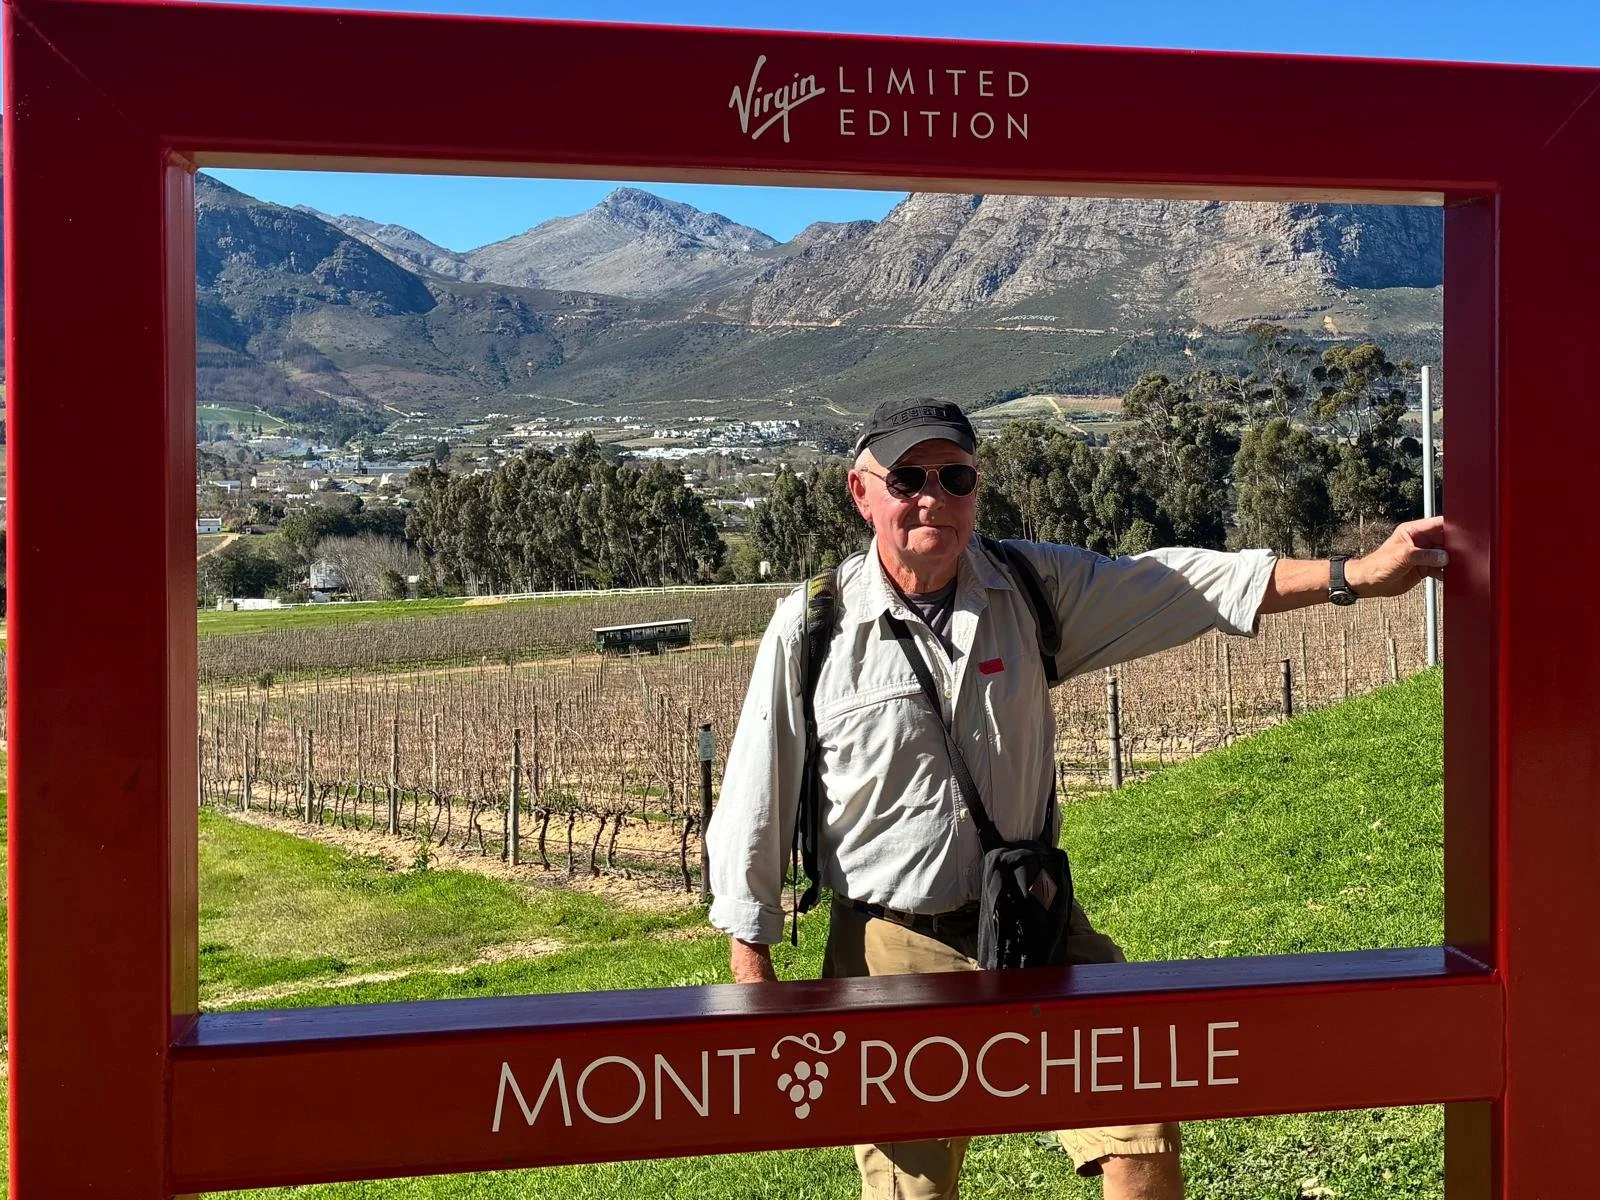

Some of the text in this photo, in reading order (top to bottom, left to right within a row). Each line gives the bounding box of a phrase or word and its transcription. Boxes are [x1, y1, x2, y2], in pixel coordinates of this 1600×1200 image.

[729, 55, 825, 142] Virgin
[840, 67, 1028, 96] LIMITED
[840, 110, 1027, 139] EDITION
[492, 1022, 1239, 1132] MONT ROCHELLE
